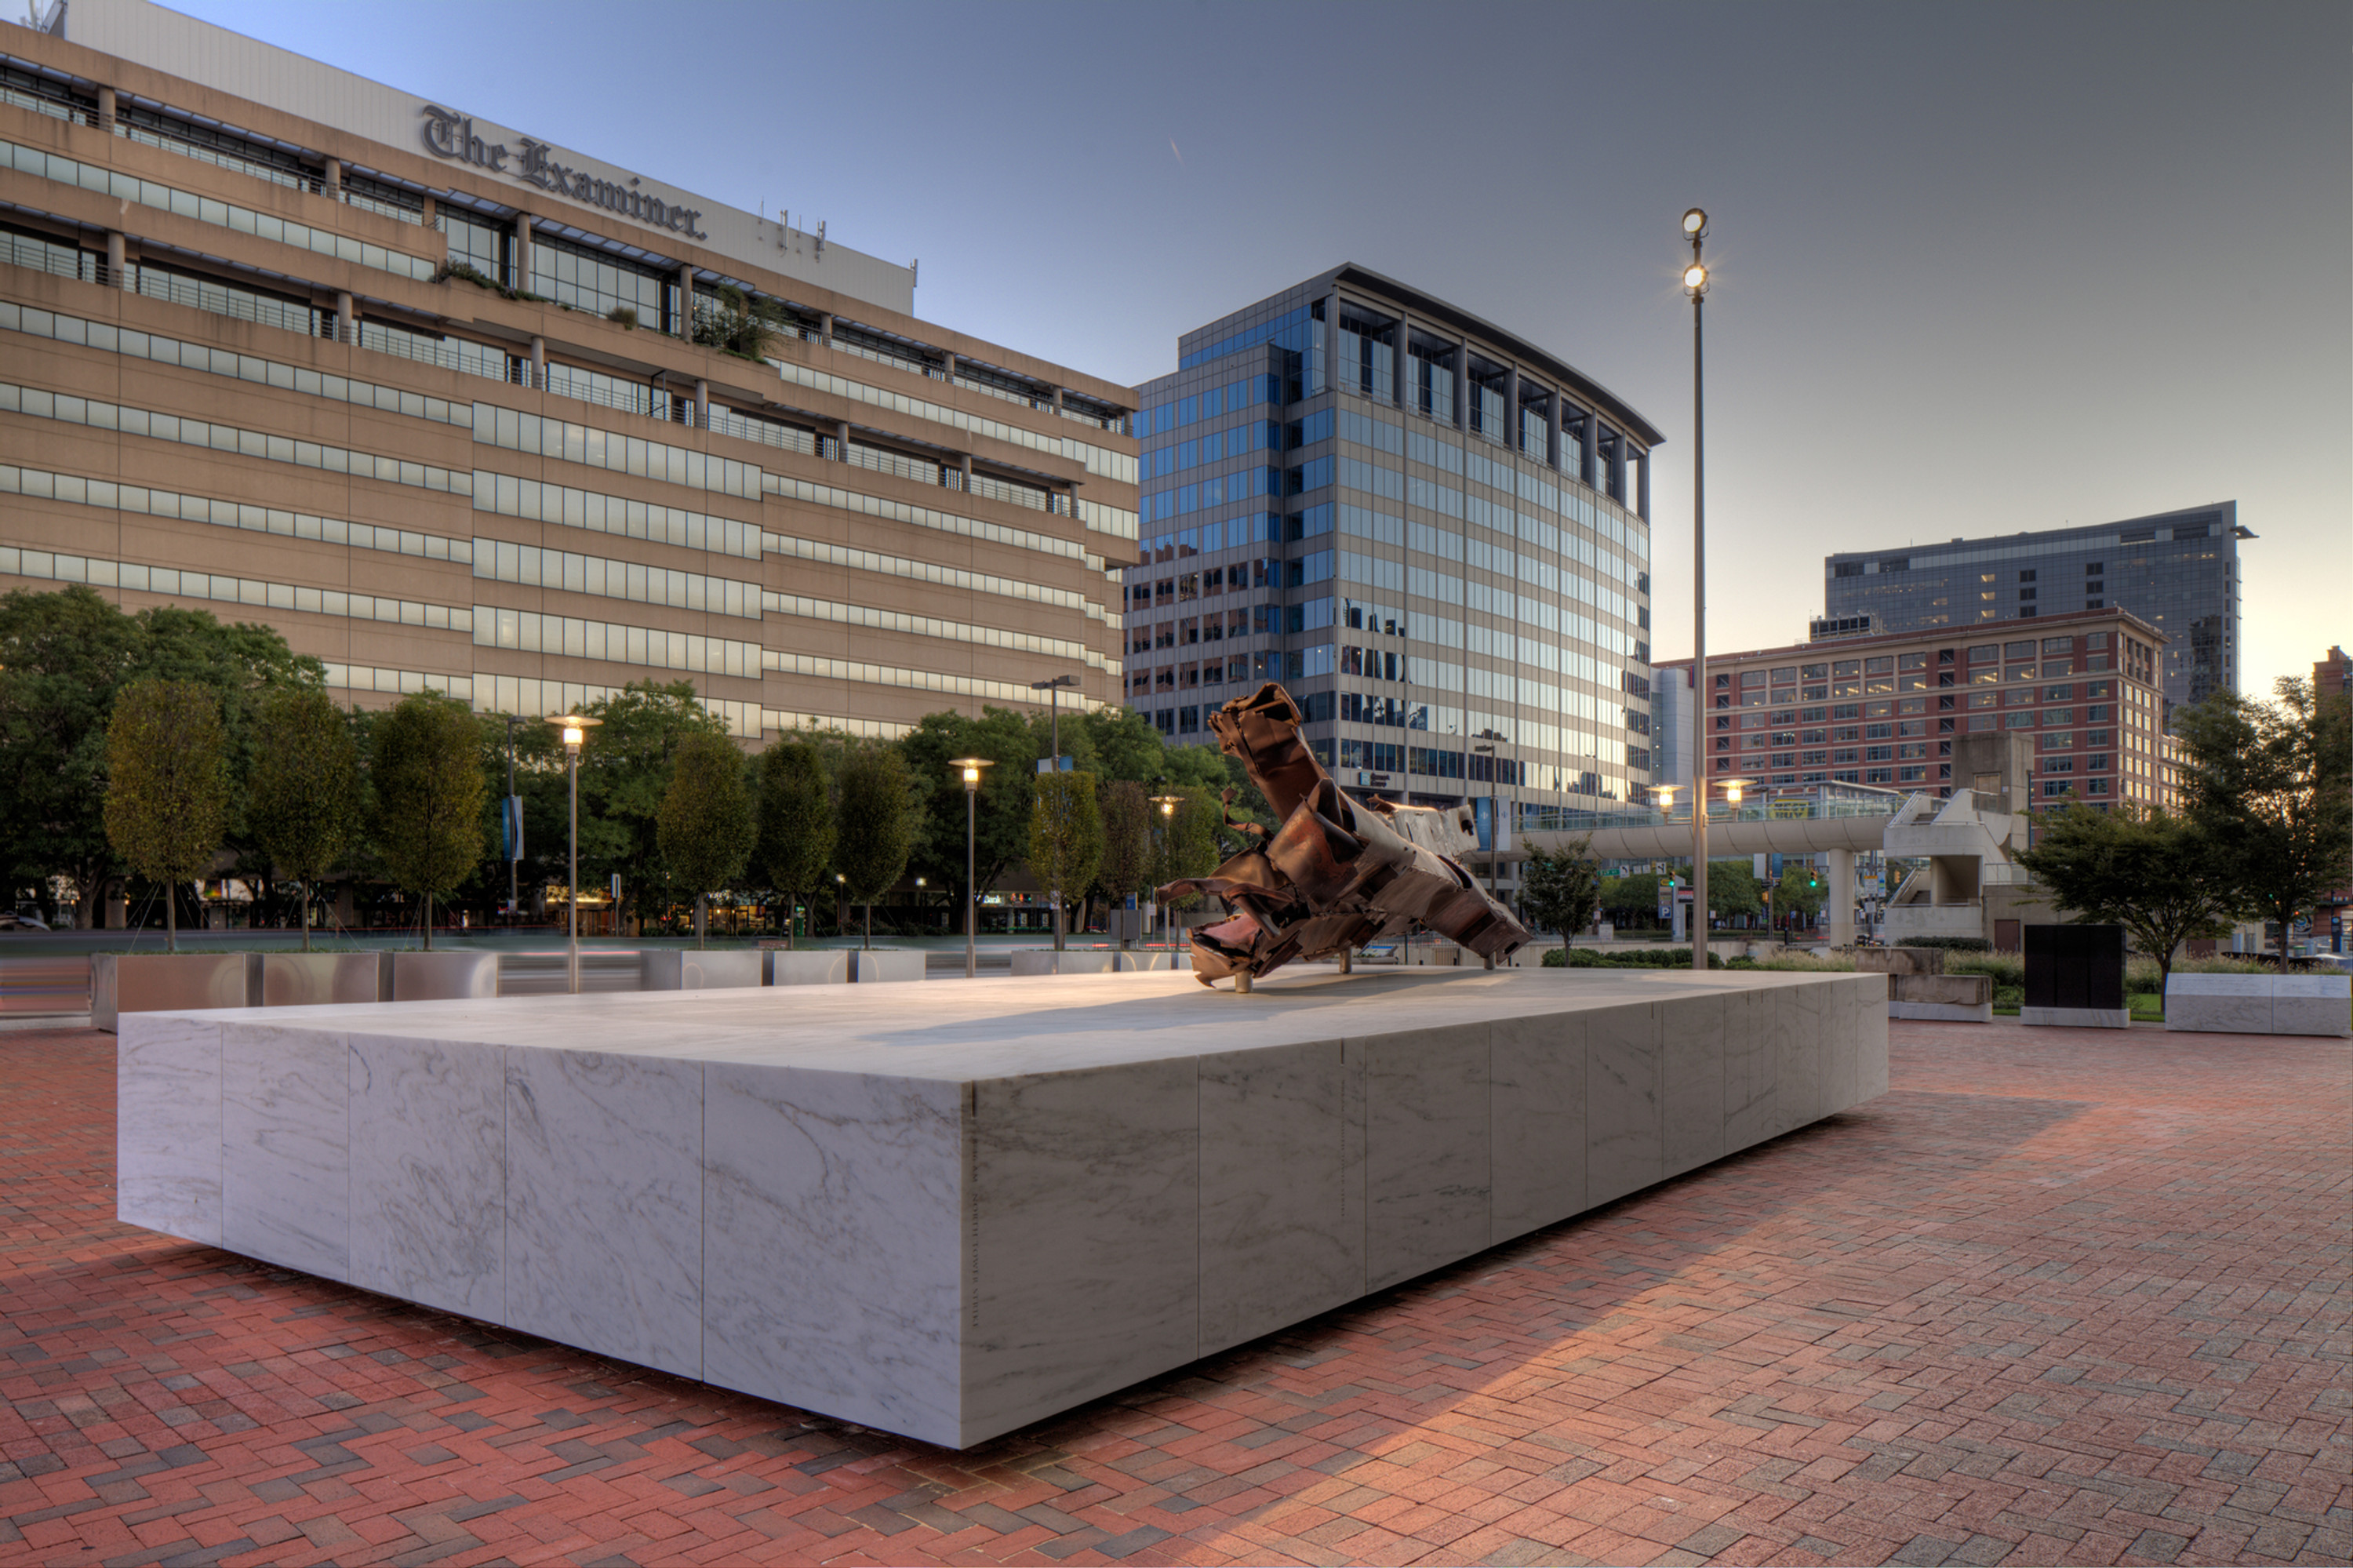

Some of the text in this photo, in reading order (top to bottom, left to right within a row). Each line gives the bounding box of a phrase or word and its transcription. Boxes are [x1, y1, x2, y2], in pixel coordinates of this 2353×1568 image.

[421, 104, 508, 173] The
[1663, 908, 1669, 916] P
[972, 1166, 979, 1183] AM
